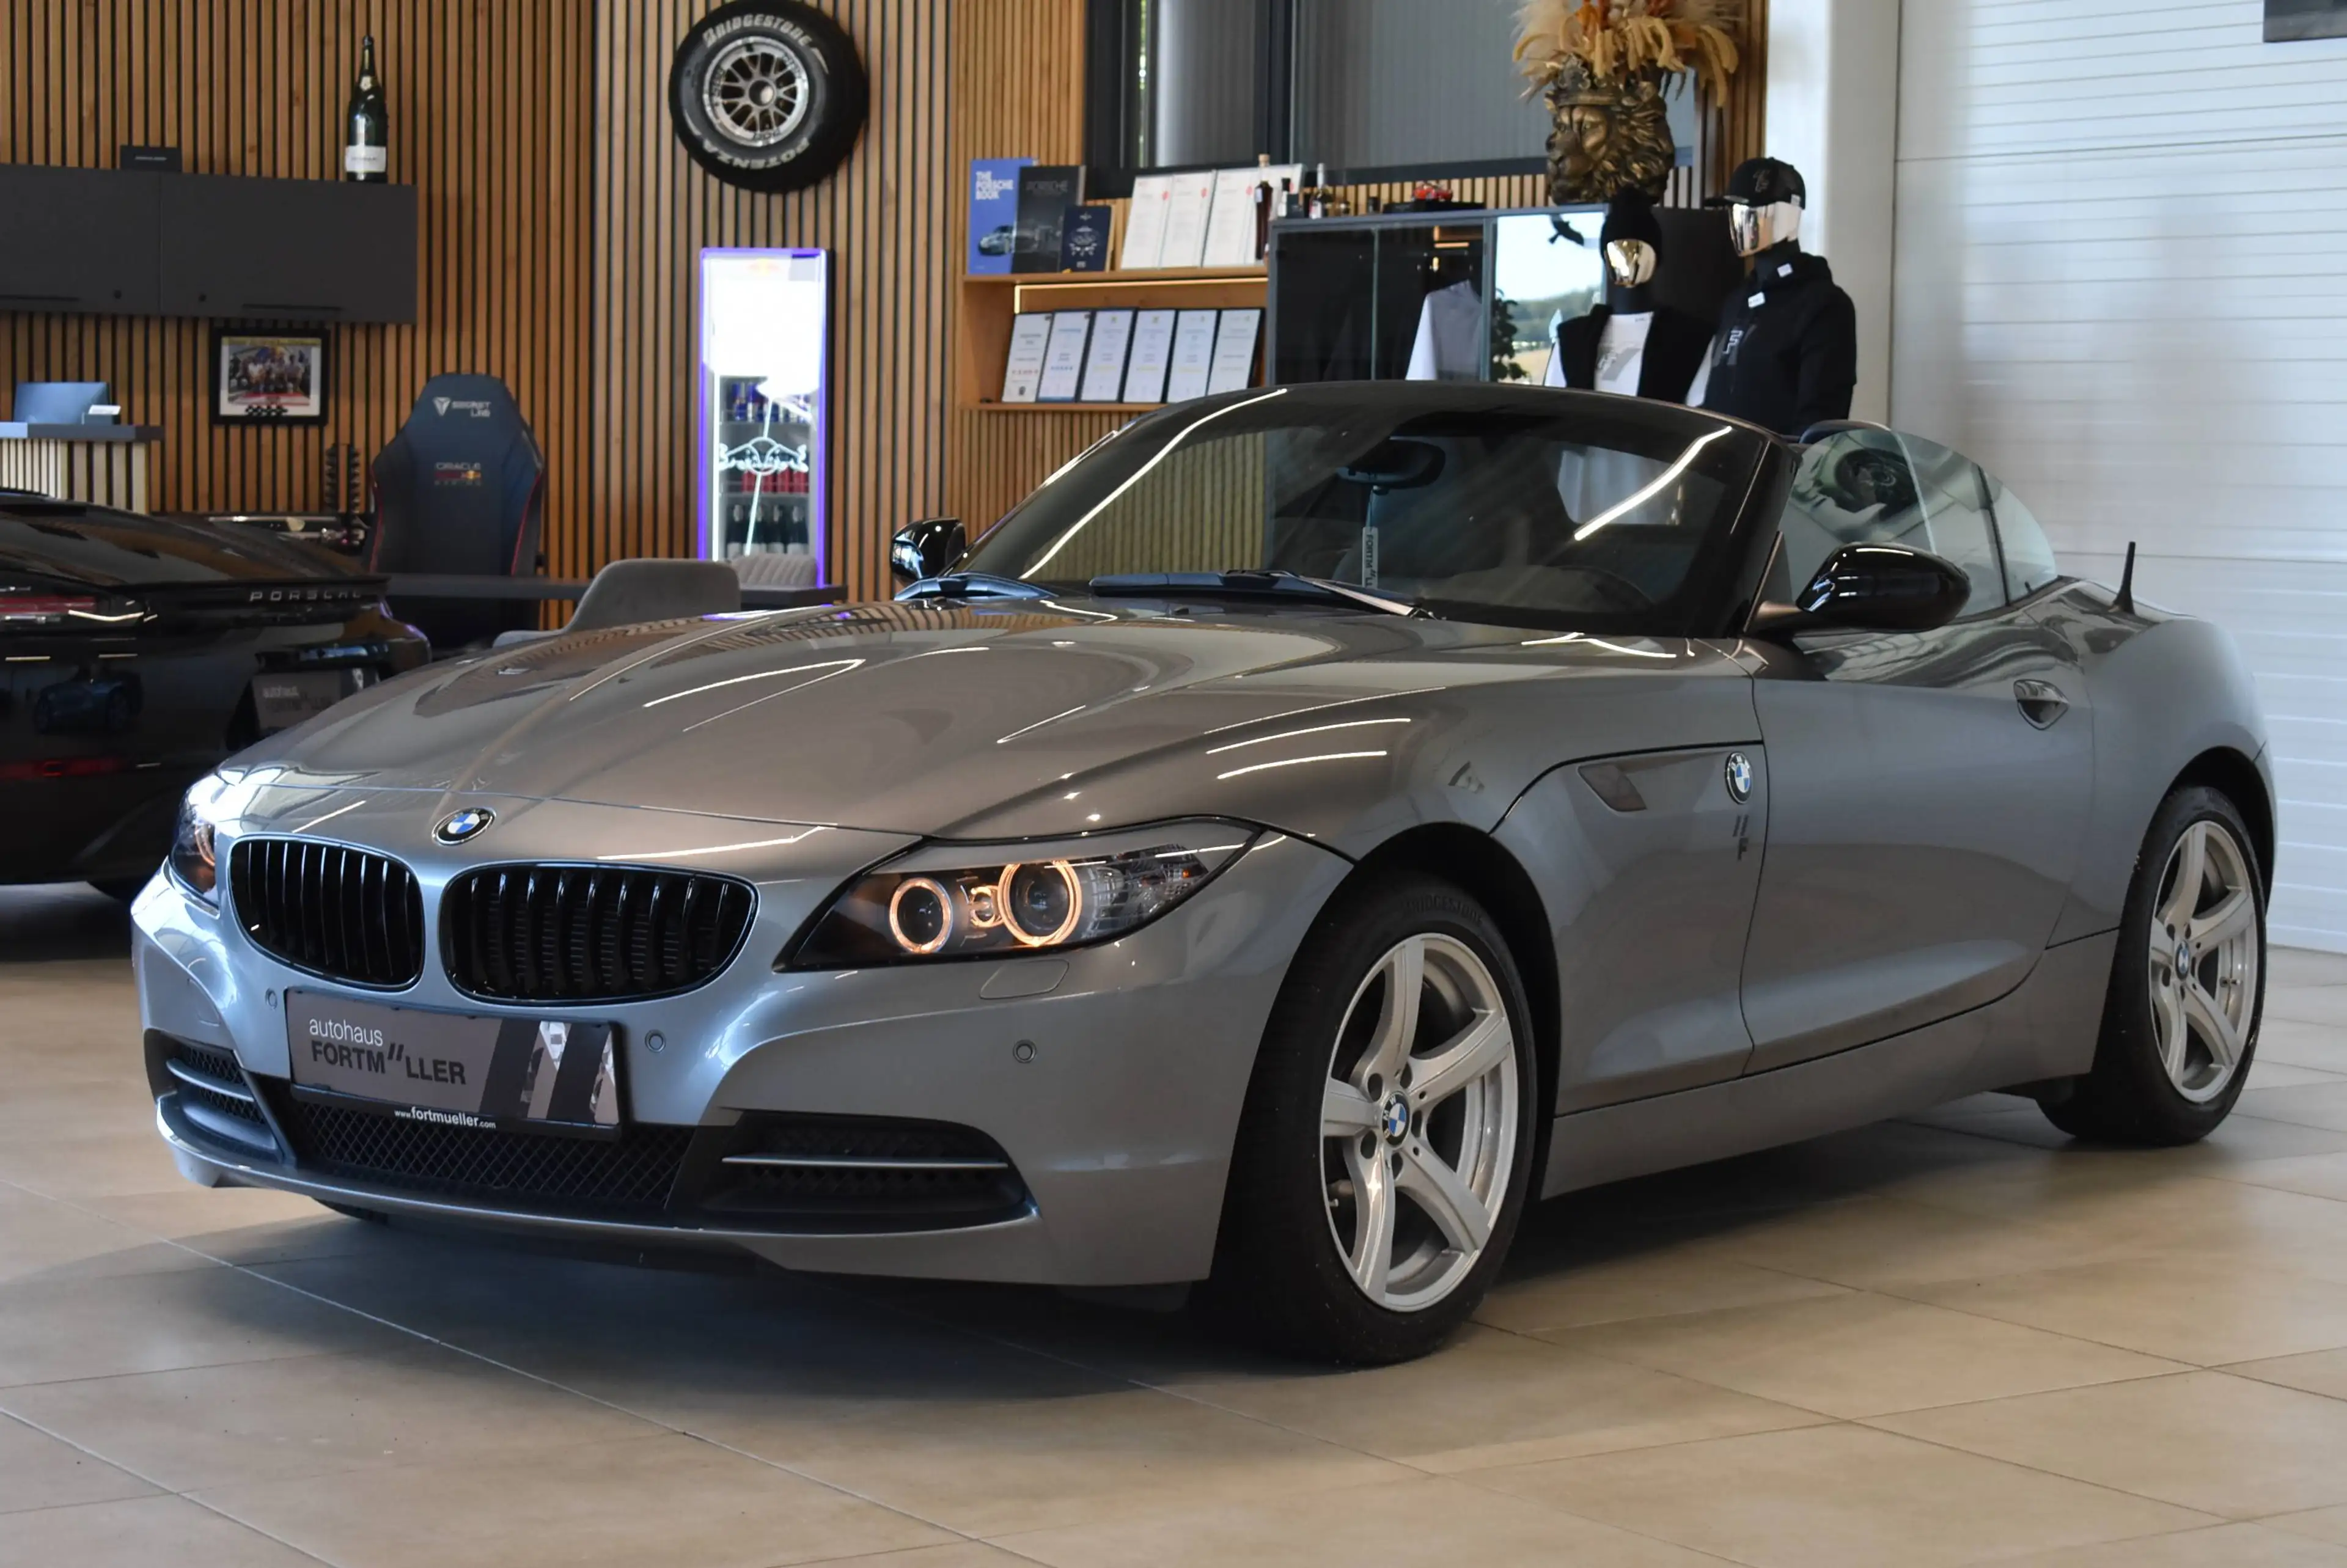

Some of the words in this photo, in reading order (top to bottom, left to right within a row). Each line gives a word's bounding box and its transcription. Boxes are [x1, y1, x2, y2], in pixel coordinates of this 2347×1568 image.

[703, 13, 812, 48] BRIDGESTONE
[704, 136, 810, 169] POTENZA
[309, 1018, 384, 1047] autohaus
[394, 1106, 496, 1129] www.fortmueller.com
